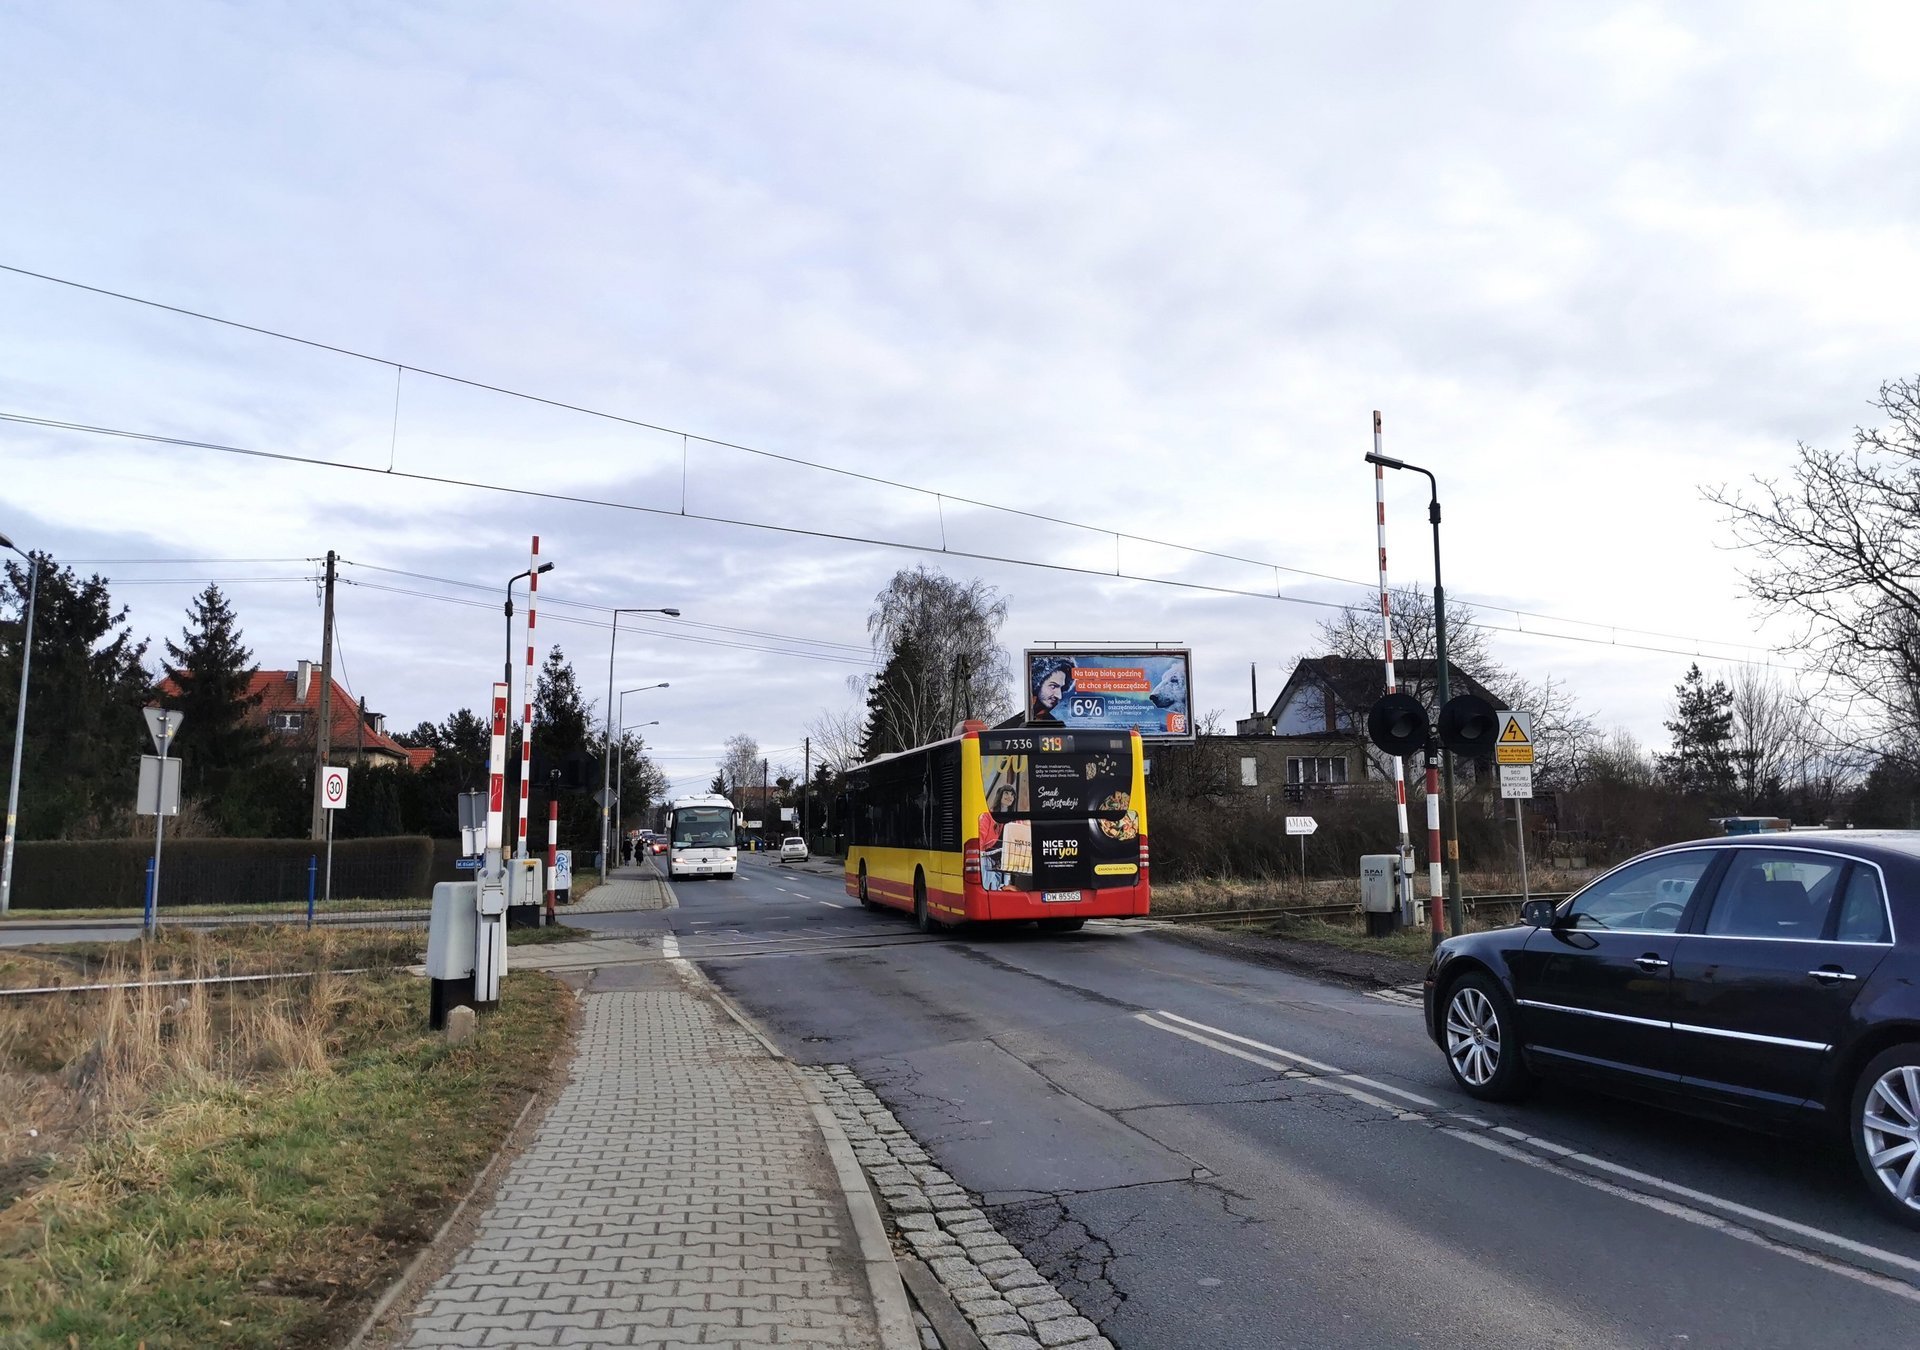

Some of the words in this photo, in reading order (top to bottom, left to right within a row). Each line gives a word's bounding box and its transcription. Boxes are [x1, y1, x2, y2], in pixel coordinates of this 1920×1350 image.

[1084, 670, 1099, 679] taką
[1117, 670, 1142, 679] godzinę
[1078, 681, 1086, 689] aż
[1087, 681, 1102, 689] chce
[1103, 682, 1112, 690] się
[1113, 681, 1148, 690] oszczędzać
[1073, 699, 1103, 716] 6%
[1004, 738, 1033, 750] 7336
[1041, 737, 1063, 751] 319
[329, 781, 341, 795] 30
[1037, 785, 1060, 798] Smak
[1287, 818, 1313, 828] AMAKS
[1042, 840, 1064, 848] NICE
[1065, 839, 1079, 848] TO
